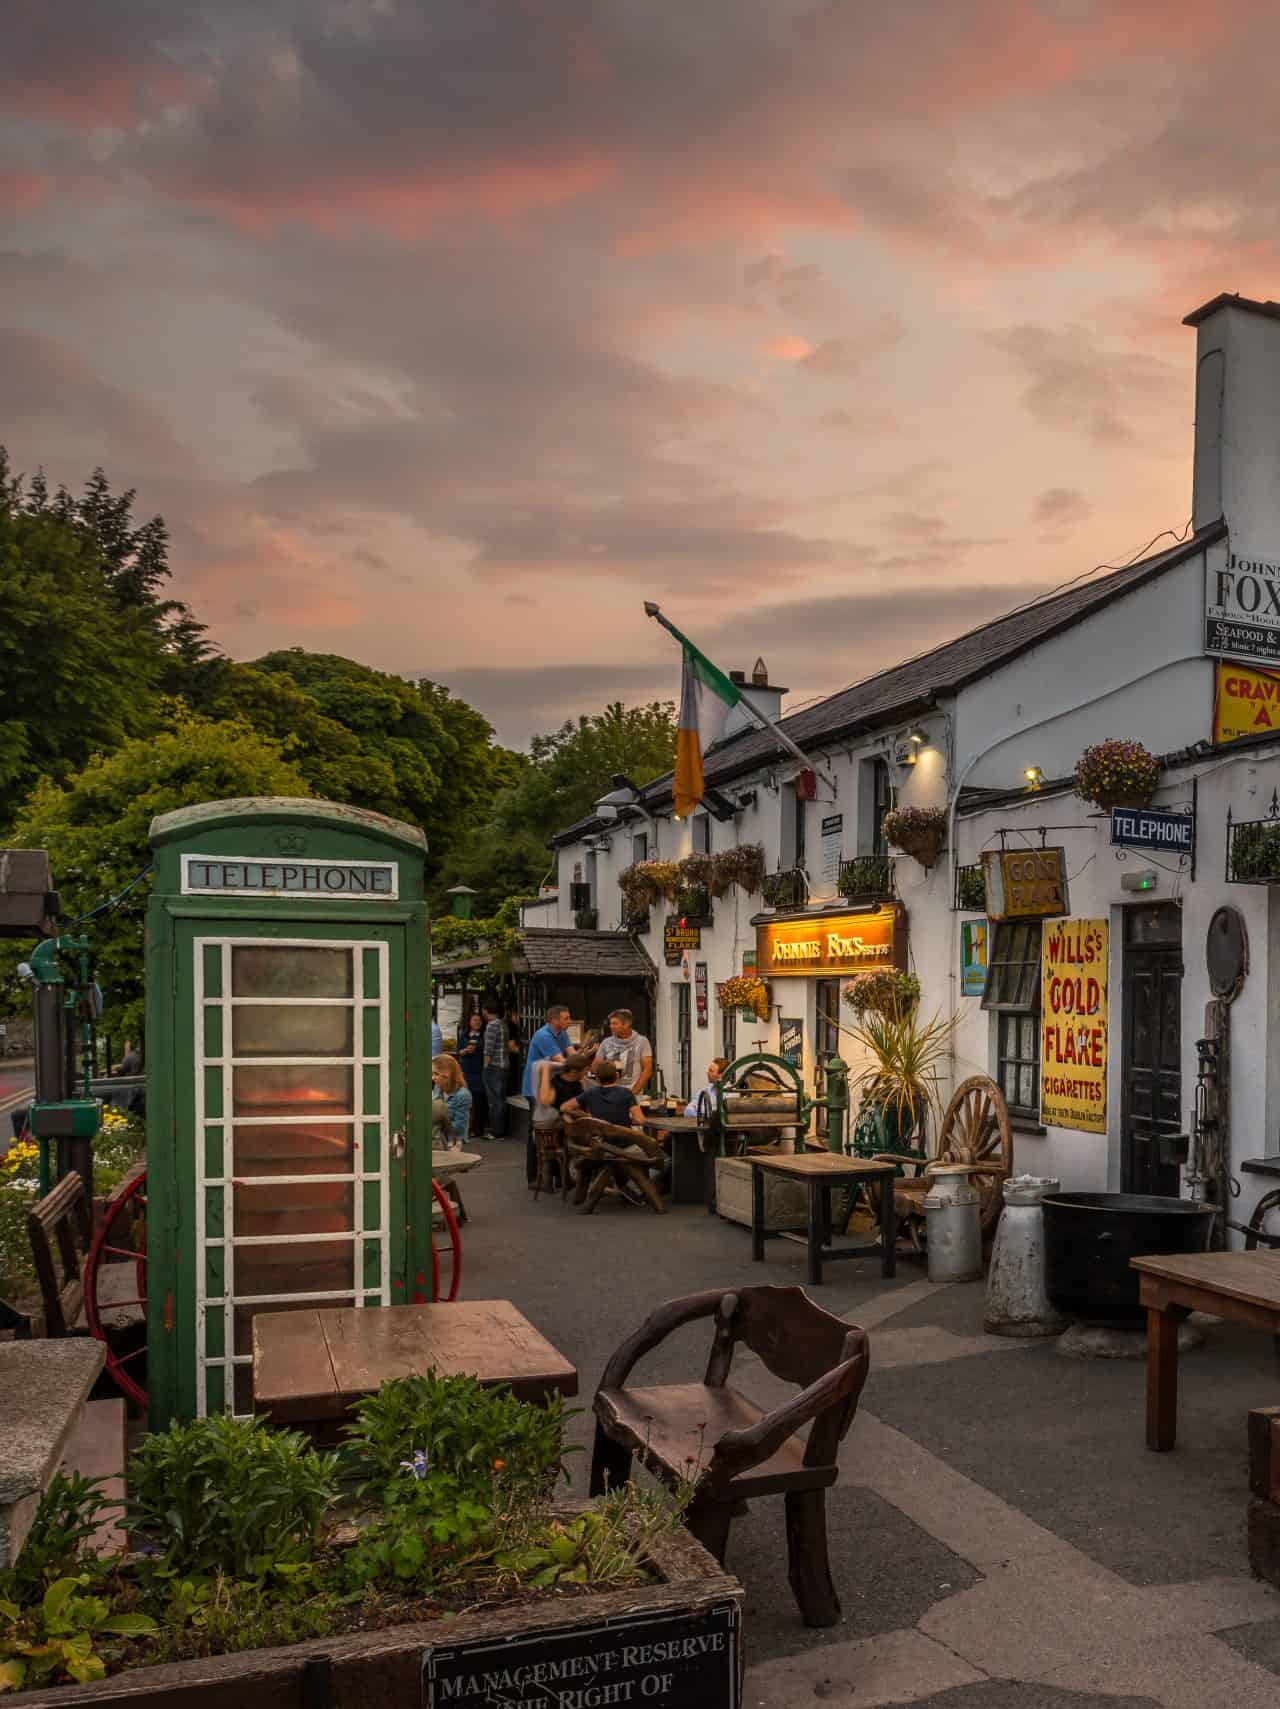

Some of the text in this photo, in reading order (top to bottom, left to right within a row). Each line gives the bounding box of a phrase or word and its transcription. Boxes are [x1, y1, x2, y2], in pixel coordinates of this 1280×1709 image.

[1215, 622, 1264, 642] SEAFOOD
[1266, 630, 1278, 644] &
[1114, 816, 1191, 843] TELEPHONE
[197, 863, 387, 891] TELEPHONE
[771, 938, 821, 960] JOHNNIE
[826, 932, 862, 958] FOX'S
[1044, 1077, 1102, 1101] CIGARETTES
[439, 1632, 726, 1700] MANAGEMENT RESERVE
[557, 1678, 637, 1709] RIGHT
[640, 1672, 674, 1698] OF
